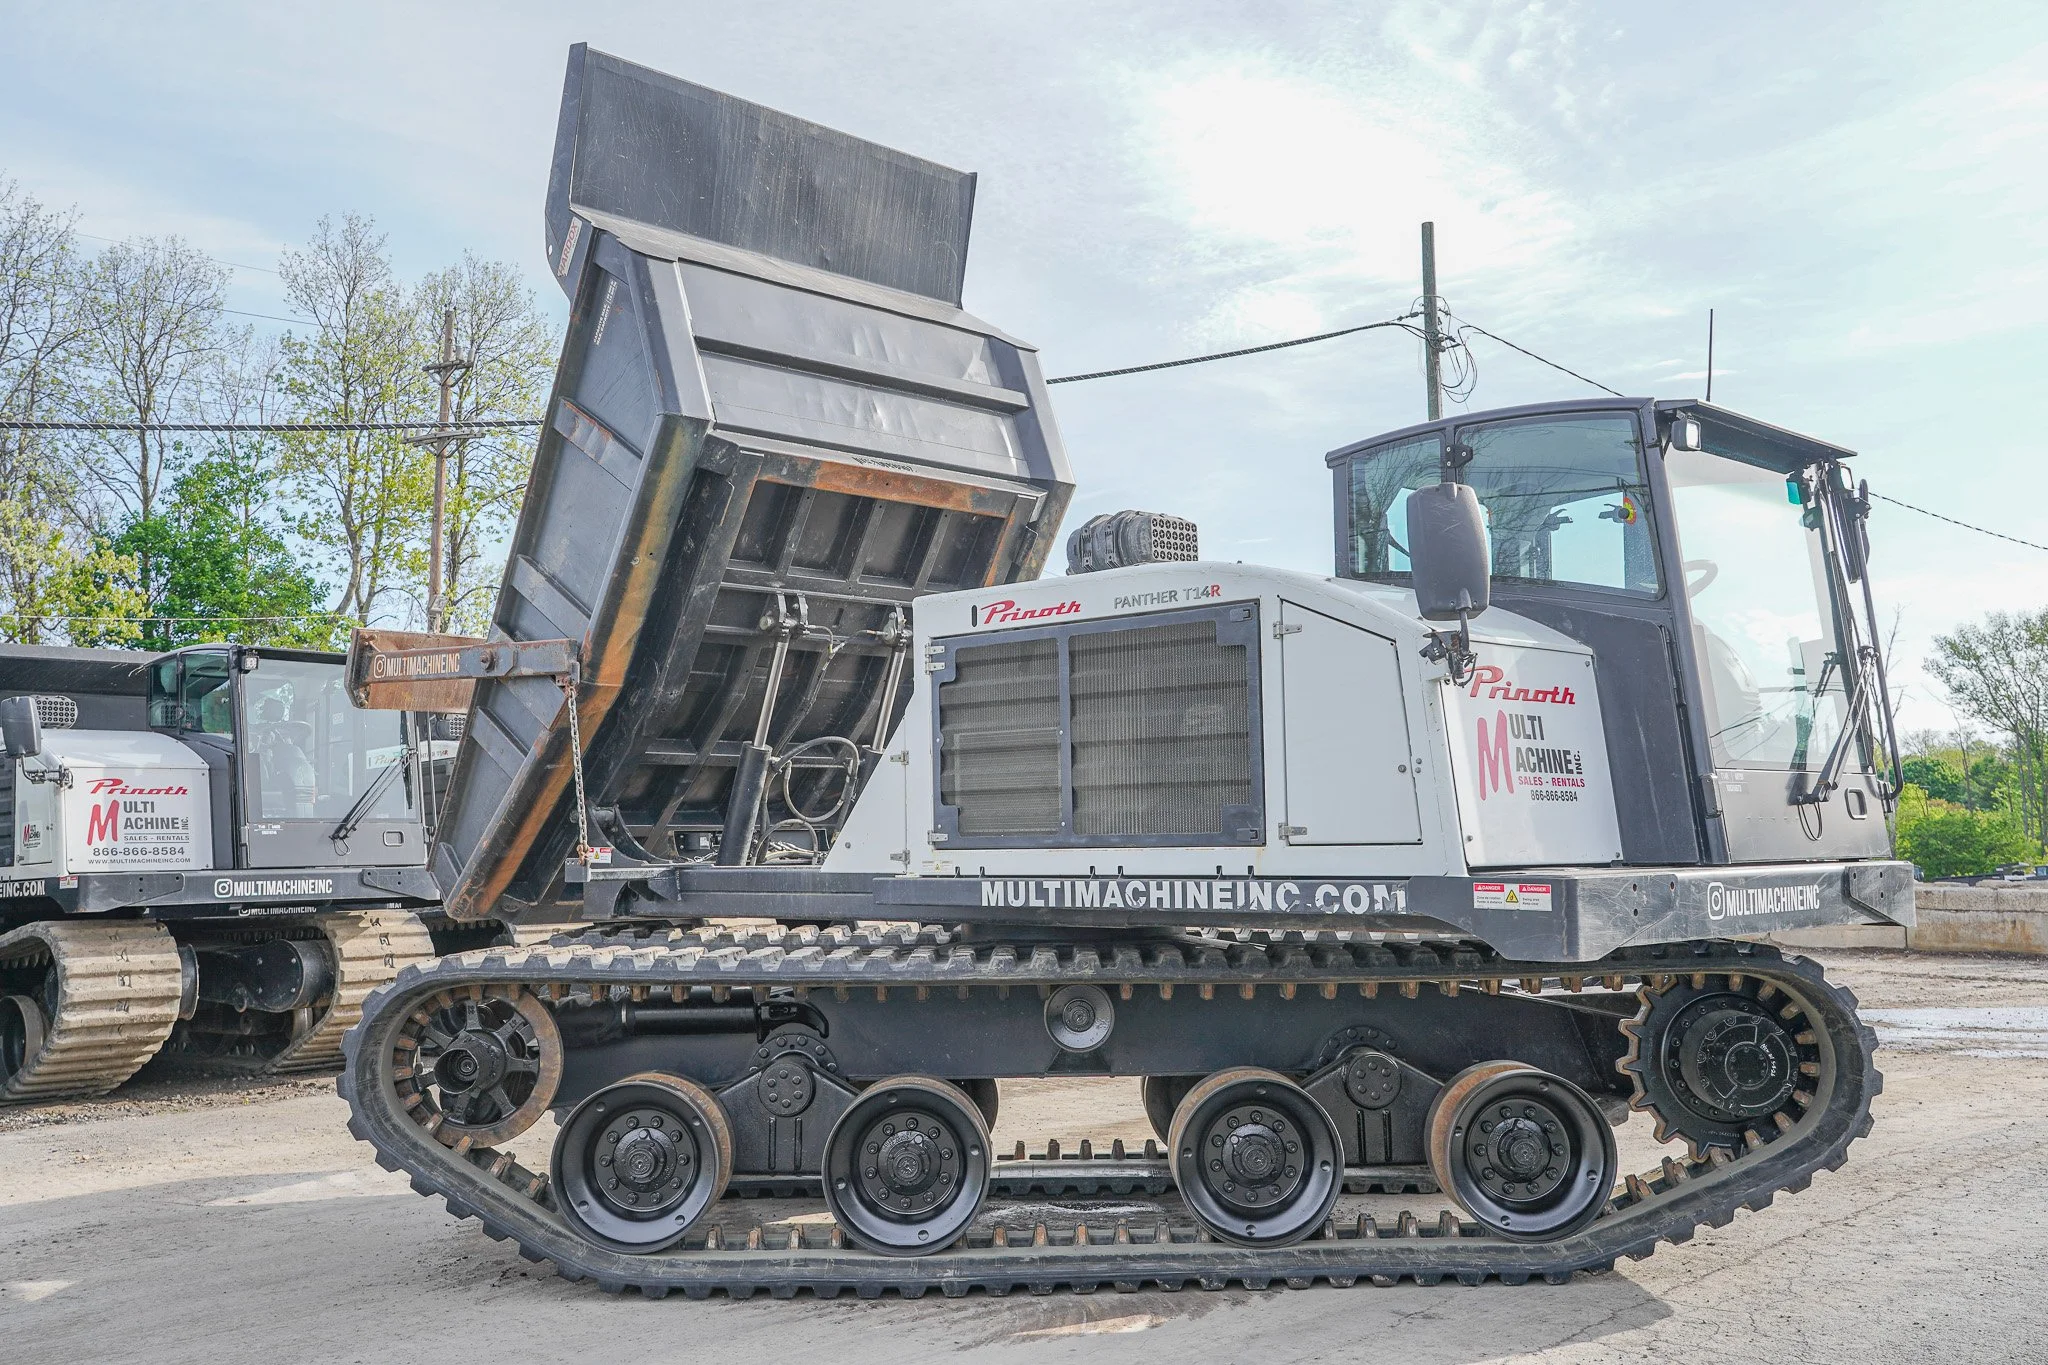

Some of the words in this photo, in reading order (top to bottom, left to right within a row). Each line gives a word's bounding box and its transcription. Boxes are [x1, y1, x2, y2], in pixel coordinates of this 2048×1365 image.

[557, 222, 578, 275] HARDOX
[1114, 590, 1178, 609] PANTHER
[1183, 584, 1221, 601] T14R
[980, 600, 1081, 625] Prinoth
[387, 653, 460, 677] MULTIMACHINEINC
[1463, 665, 1575, 705] Prinoth
[87, 778, 187, 795] Prinoth
[1518, 776, 1543, 786] SALES
[1552, 777, 1585, 787] RENTALS
[1531, 789, 1578, 802] 866-866-8584
[93, 847, 185, 856] 866-866-8584
[233, 879, 333, 897] MULTIMACHINEINC
[1726, 884, 1820, 917] MULTIMACHINEINC
